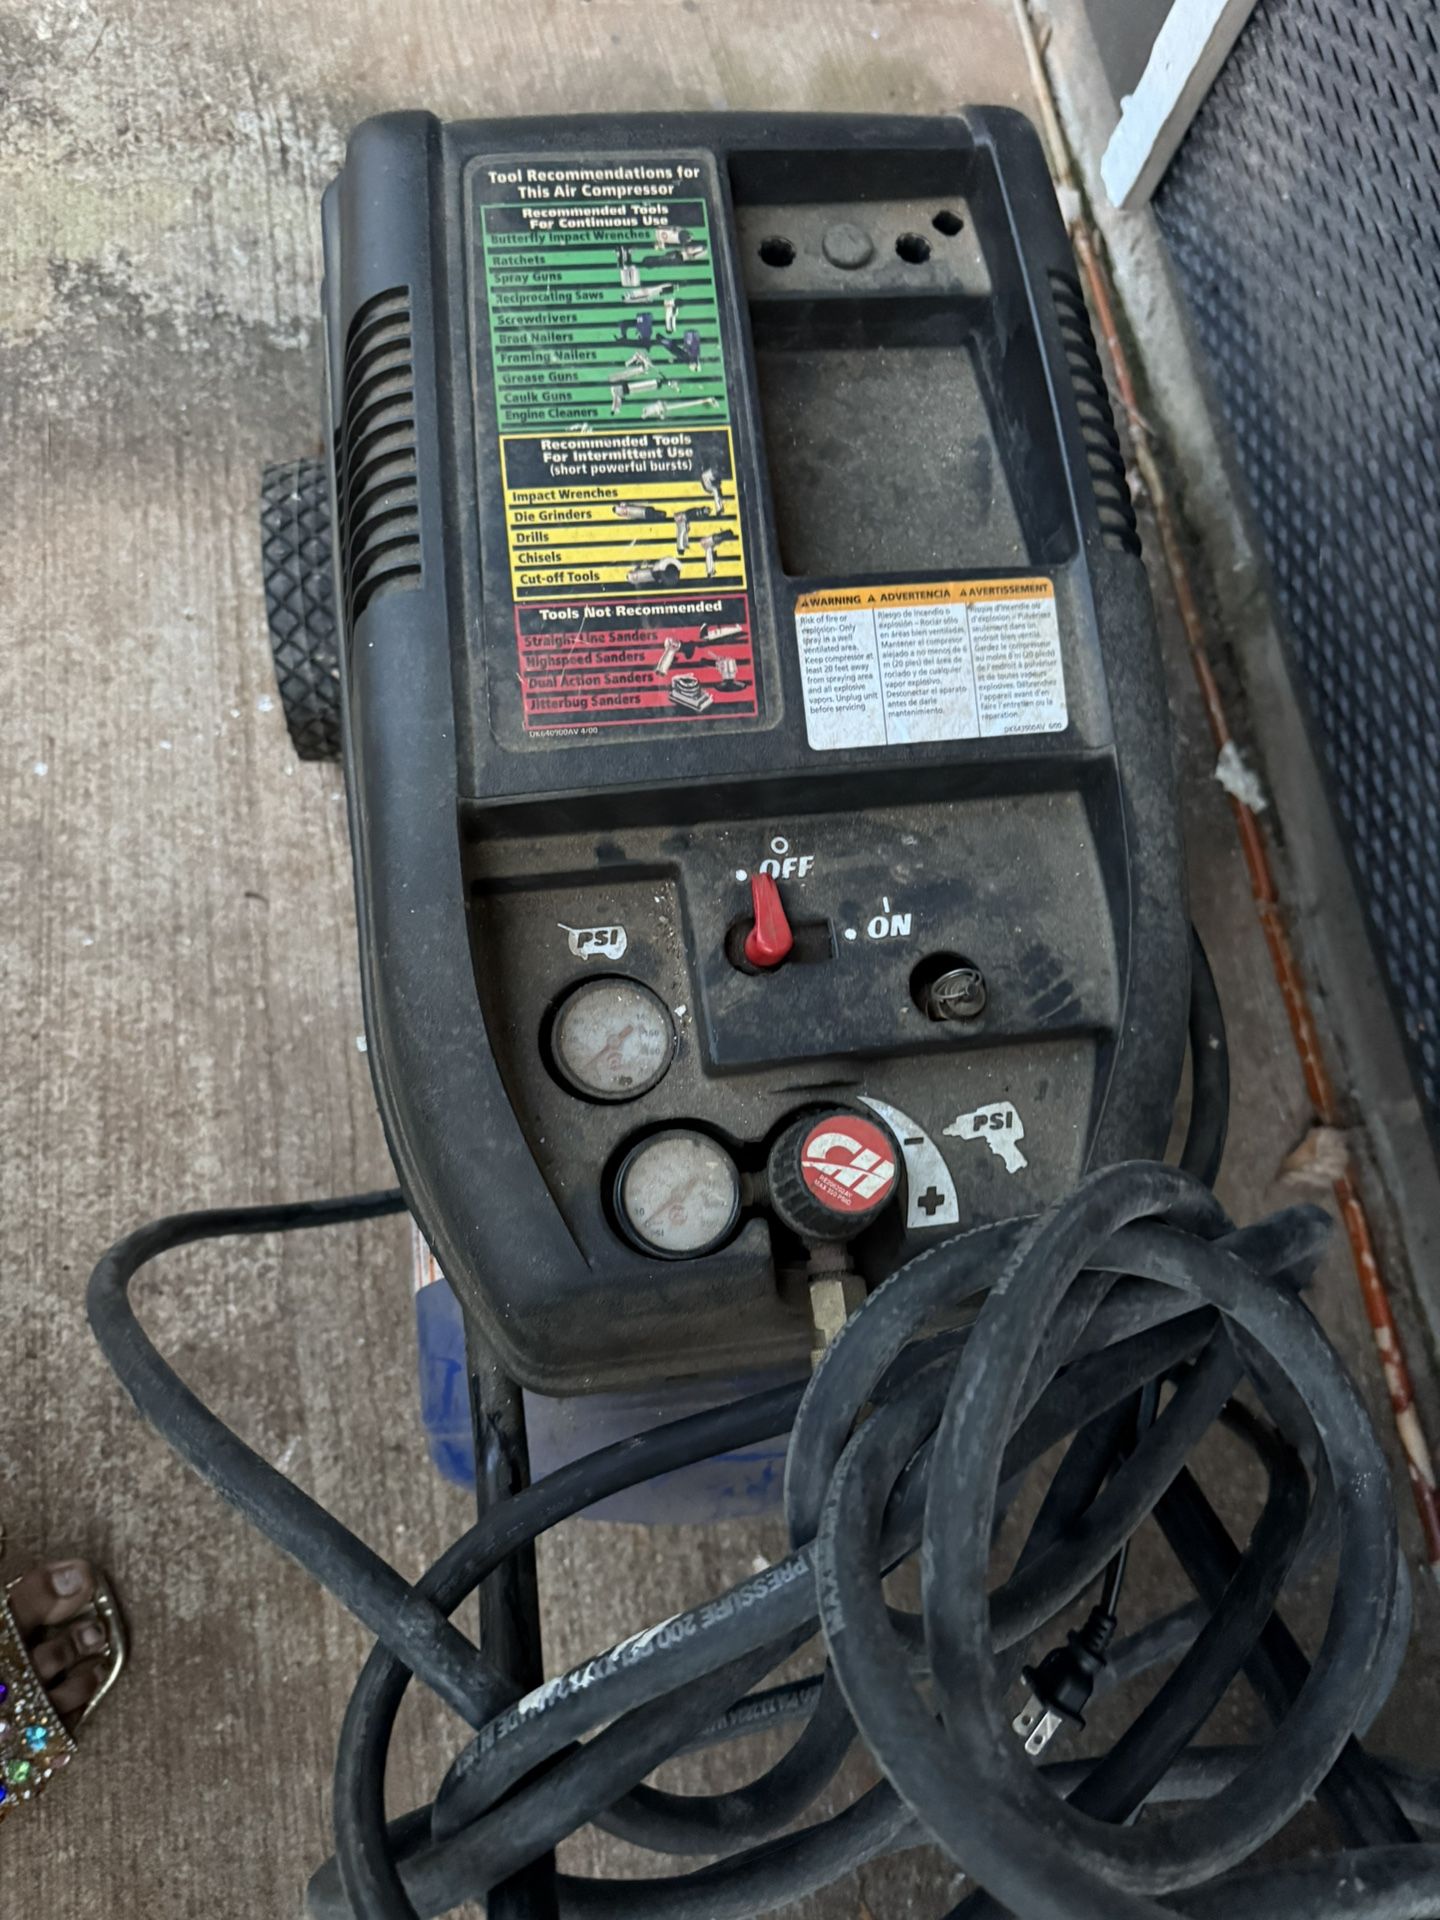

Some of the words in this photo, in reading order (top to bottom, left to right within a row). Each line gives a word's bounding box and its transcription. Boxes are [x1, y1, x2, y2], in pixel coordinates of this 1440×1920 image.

[488, 169, 522, 183] Tool
[527, 166, 672, 182] Recommendations
[677, 165, 700, 178] for
[518, 186, 549, 199] This
[554, 185, 577, 198] Air
[582, 183, 674, 198] Compressor
[522, 205, 626, 218] Recommended
[631, 204, 668, 214] Tools
[530, 219, 554, 229] For
[559, 217, 638, 228] Continuous
[643, 216, 668, 226] Use
[491, 232, 545, 245] Butterfly
[550, 231, 590, 244] Impact
[594, 228, 650, 240] Wrenches
[492, 255, 545, 265] Ratchets
[494, 274, 529, 284] Spray
[533, 272, 562, 281] Guns
[496, 292, 572, 304] Reciprocating
[576, 291, 603, 300] Saws
[498, 314, 577, 324] Screwdrivers
[499, 334, 527, 344] Brad
[532, 332, 573, 342] Nailers
[501, 352, 550, 364] Framing
[555, 349, 597, 360] Nailers
[502, 373, 544, 383] Grease
[549, 372, 578, 381] Guns
[504, 392, 538, 402] Caulk
[542, 391, 572, 401] Guns
[506, 411, 544, 422] Engine
[548, 408, 598, 418] Cleaners
[541, 436, 648, 450] Recommended
[653, 434, 691, 445] Tools
[543, 452, 568, 463] For
[573, 449, 663, 462] Intermittent
[668, 447, 693, 458] Use
[550, 463, 587, 476] (short
[591, 461, 647, 476] powerful
[650, 459, 692, 472] bursts)
[513, 490, 554, 503] Impact
[559, 488, 618, 499] Wrenches
[514, 511, 536, 522] Die
[539, 509, 592, 520] Grinders
[516, 532, 549, 543] Drills
[518, 552, 561, 563] Chisels
[520, 571, 564, 584] Cut-off
[568, 570, 600, 582] Tools
[880, 589, 950, 602] ADVERTENCIA
[968, 584, 1048, 597] AVERTISSEMENT
[810, 595, 860, 606] WARNING
[539, 608, 579, 620] Tools
[584, 606, 611, 618] Not
[616, 600, 722, 617] Recommended
[840, 624, 855, 633] Only
[525, 636, 575, 649] Straight
[581, 633, 605, 644] Line
[609, 630, 657, 642] Sanders
[804, 645, 839, 653] ventilated
[526, 652, 591, 668] Highspeed
[596, 651, 644, 662] Sanders
[825, 654, 864, 662] compressor
[529, 679, 557, 688] Dual
[561, 675, 600, 686] Action
[605, 672, 653, 684] Sanders
[834, 684, 865, 692] explosive
[531, 695, 587, 709] Jitterbug
[592, 695, 640, 706] Sanders
[836, 694, 862, 702] Unplug
[759, 855, 814, 880] OFF
[868, 914, 911, 939] ON
[577, 930, 618, 948] PSI
[973, 1112, 1012, 1131] PSI
[701, 1555, 809, 1628] PRESSURE
[658, 1618, 697, 1648] 200
